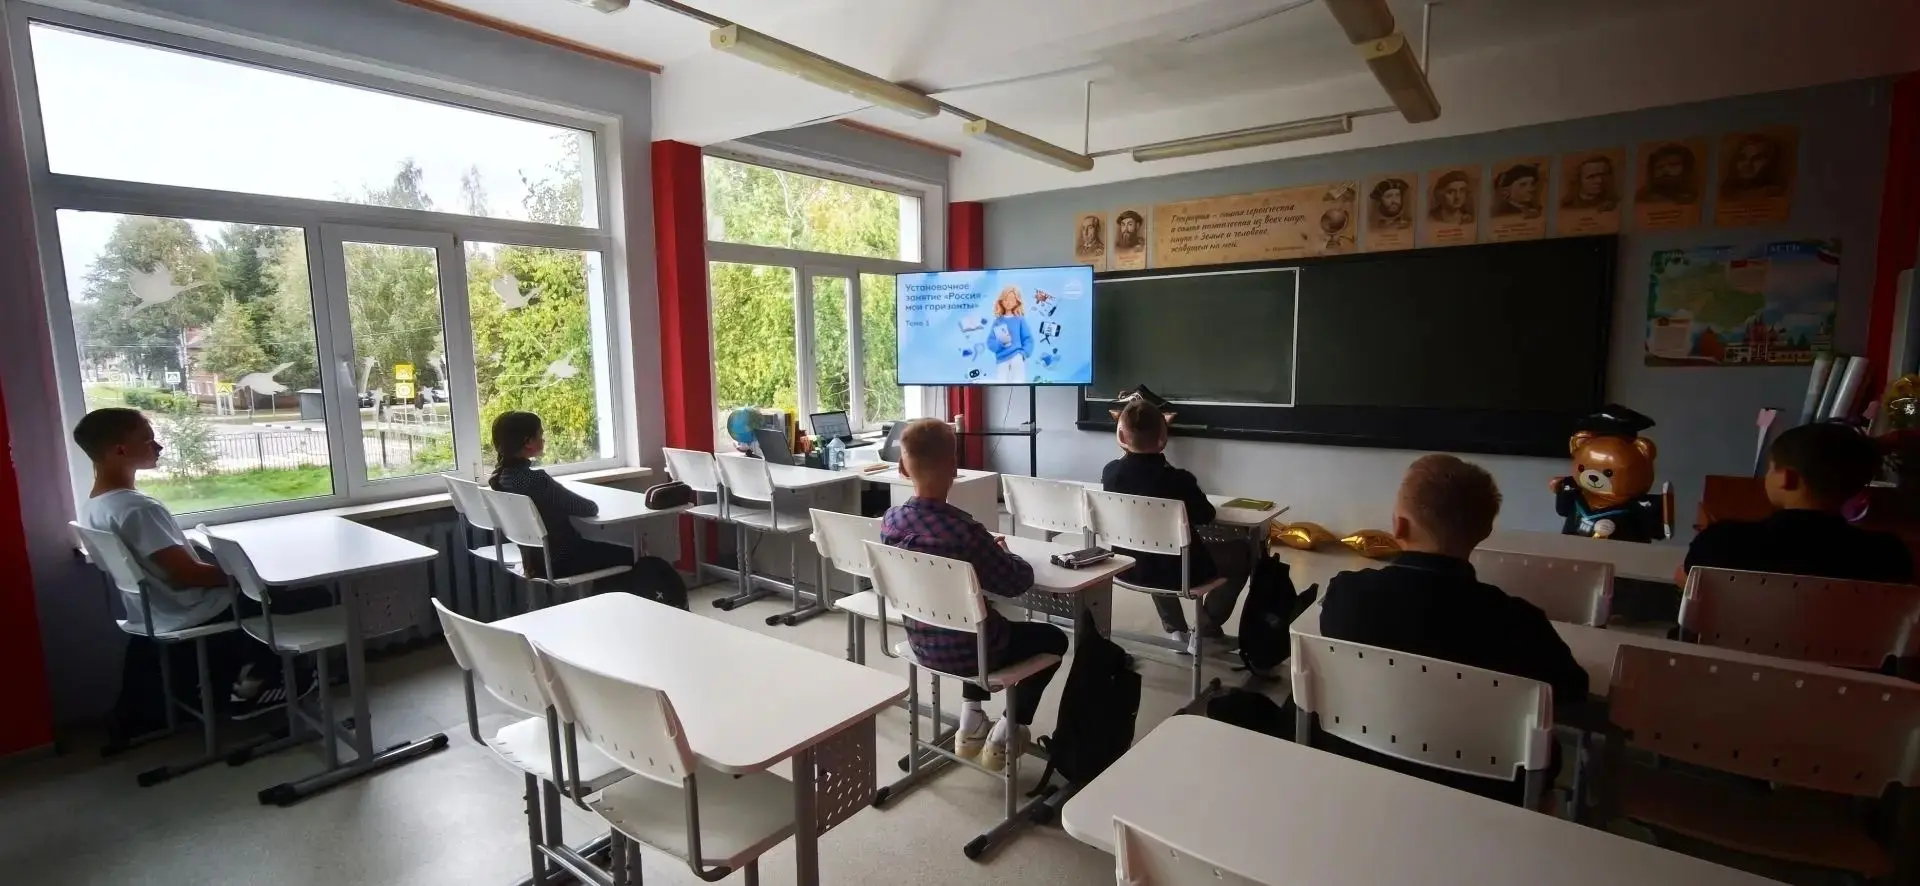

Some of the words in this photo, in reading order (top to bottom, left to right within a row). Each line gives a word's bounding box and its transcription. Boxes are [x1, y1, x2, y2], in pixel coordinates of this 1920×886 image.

[1219, 210, 1244, 218] самая
[1246, 204, 1294, 217] героическая
[1202, 220, 1251, 230] поэтическая
[1253, 219, 1262, 228] из
[1264, 214, 1281, 224] всех
[1200, 232, 1224, 241] Земле
[905, 284, 969, 292] Установочное
[905, 294, 941, 302] занятие
[944, 292, 981, 301] «Россия
[925, 302, 980, 312] горизонты»
